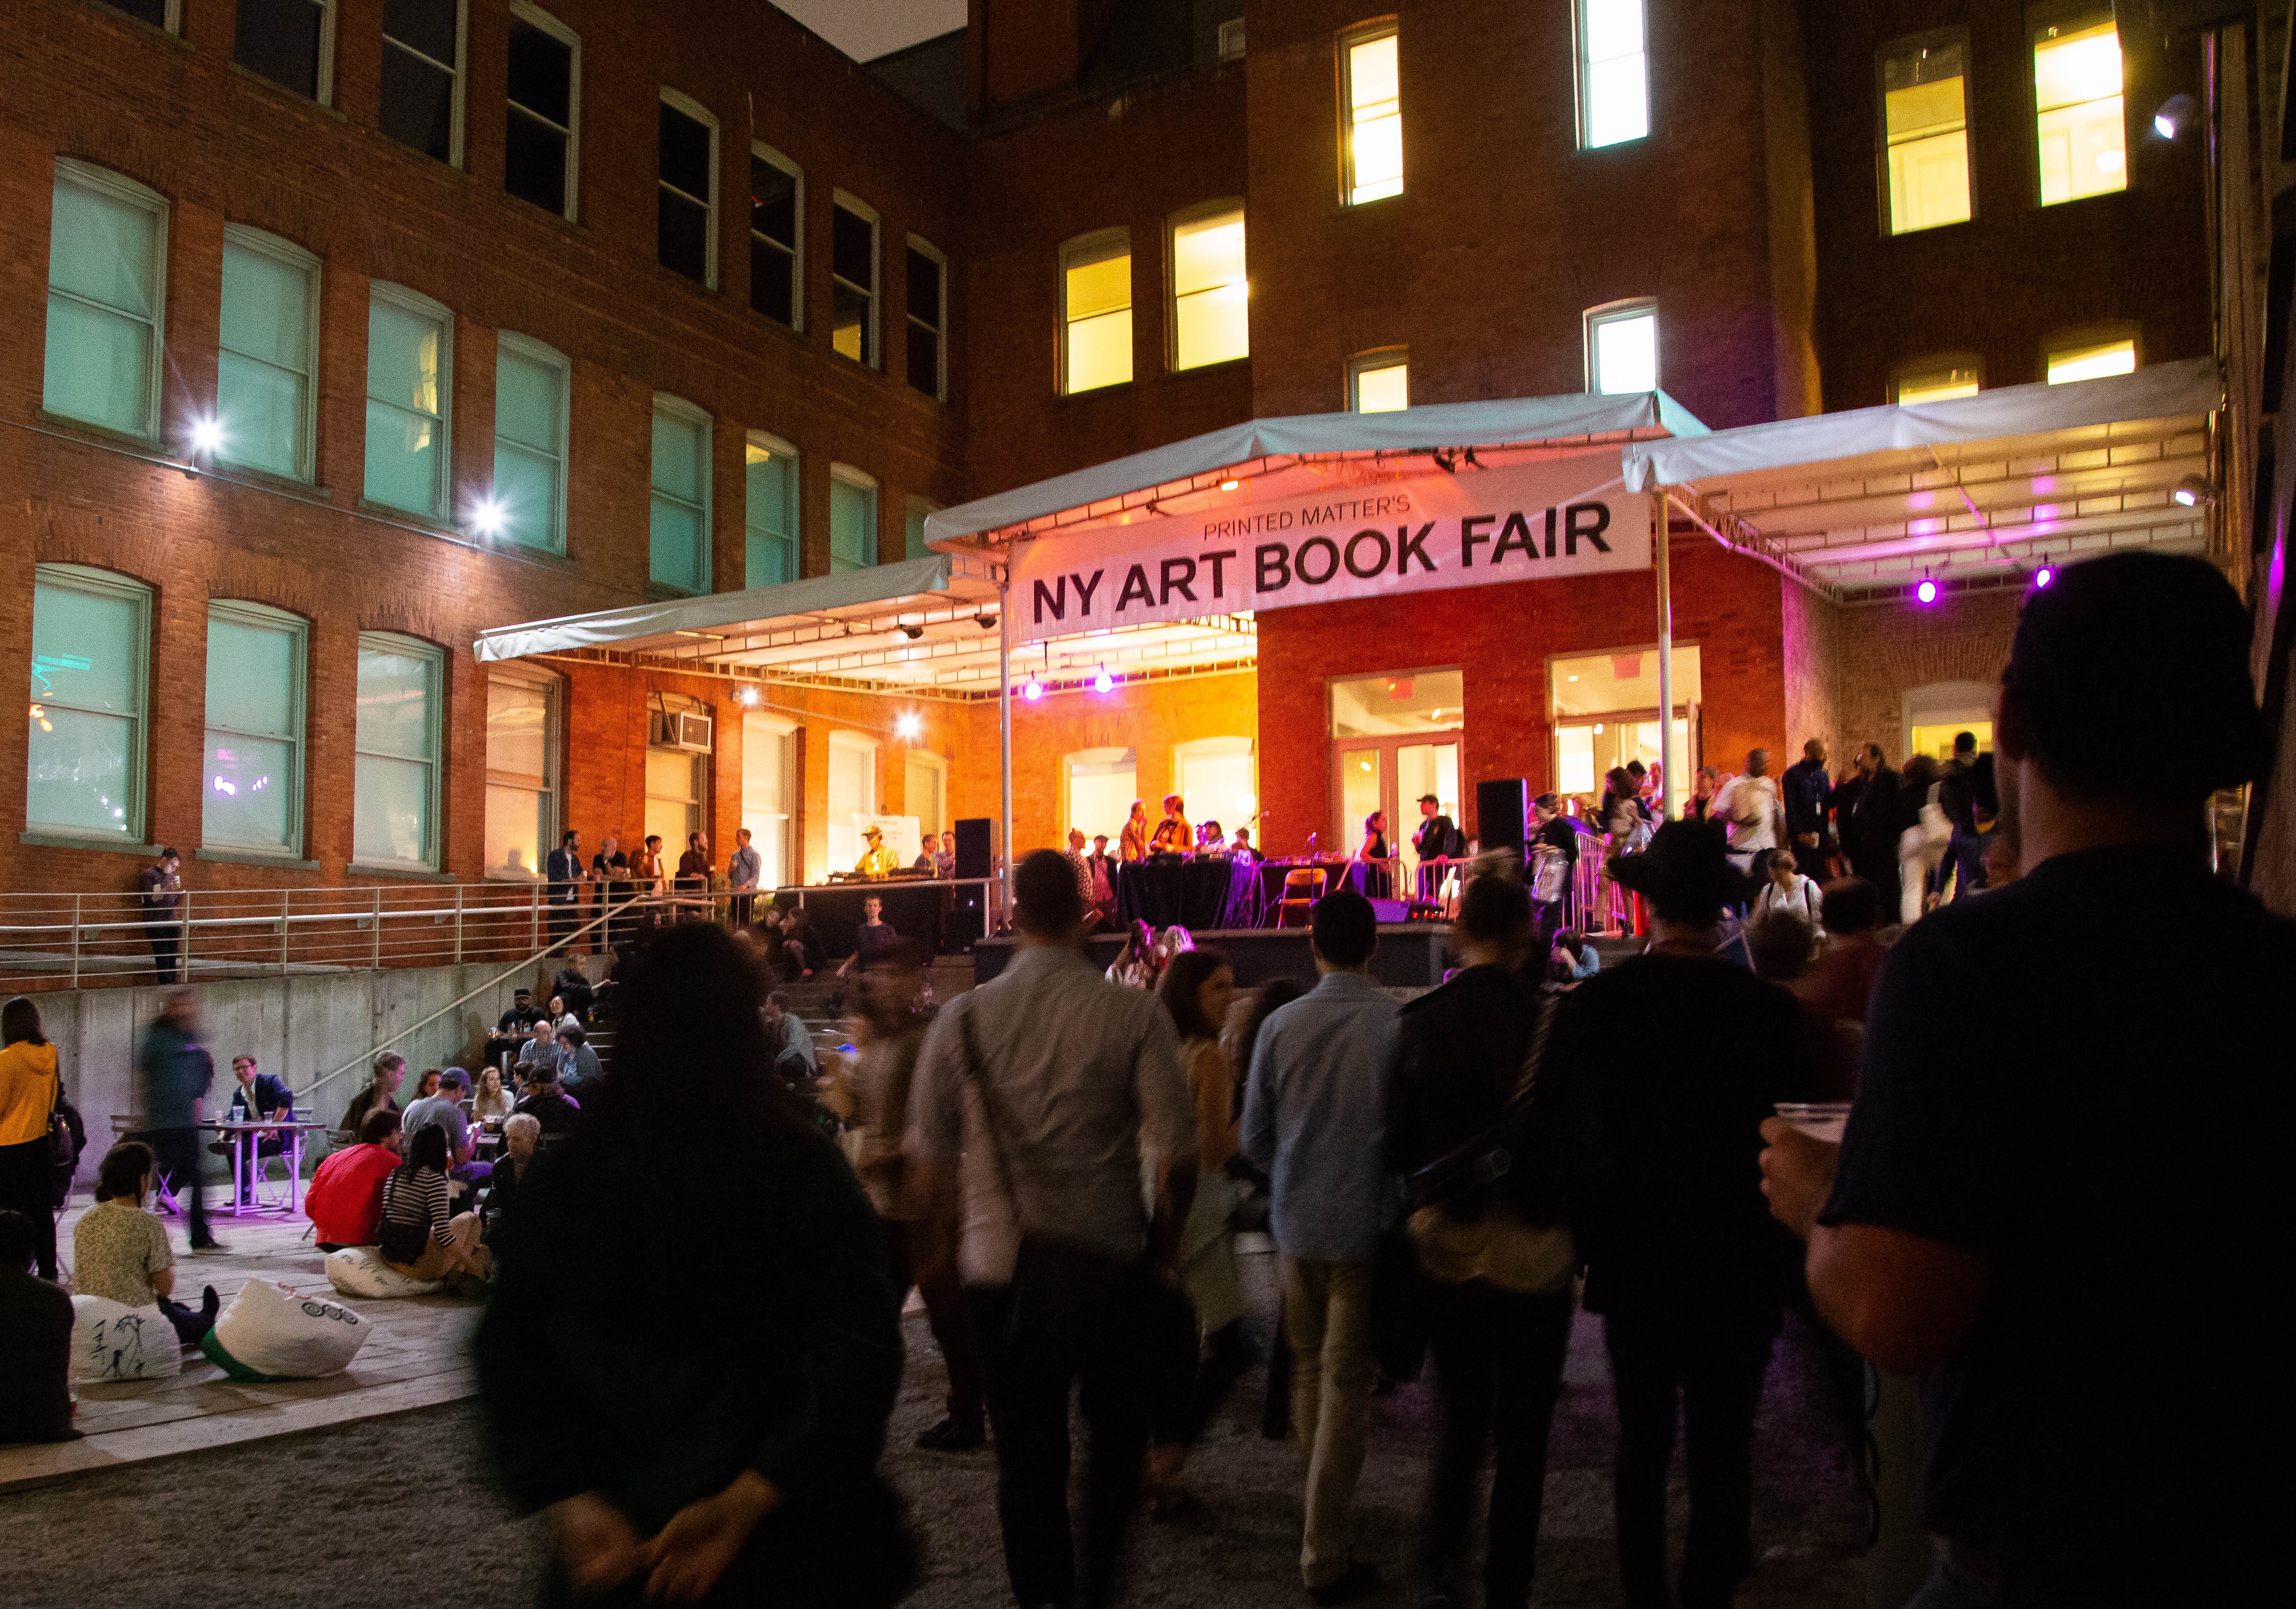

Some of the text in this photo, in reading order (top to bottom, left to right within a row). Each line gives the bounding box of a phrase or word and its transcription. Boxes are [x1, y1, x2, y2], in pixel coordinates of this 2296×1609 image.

[1204, 494, 1410, 541] PRINTED MATTER'S
[1033, 500, 1613, 623] NY ART BOOK FAIR
